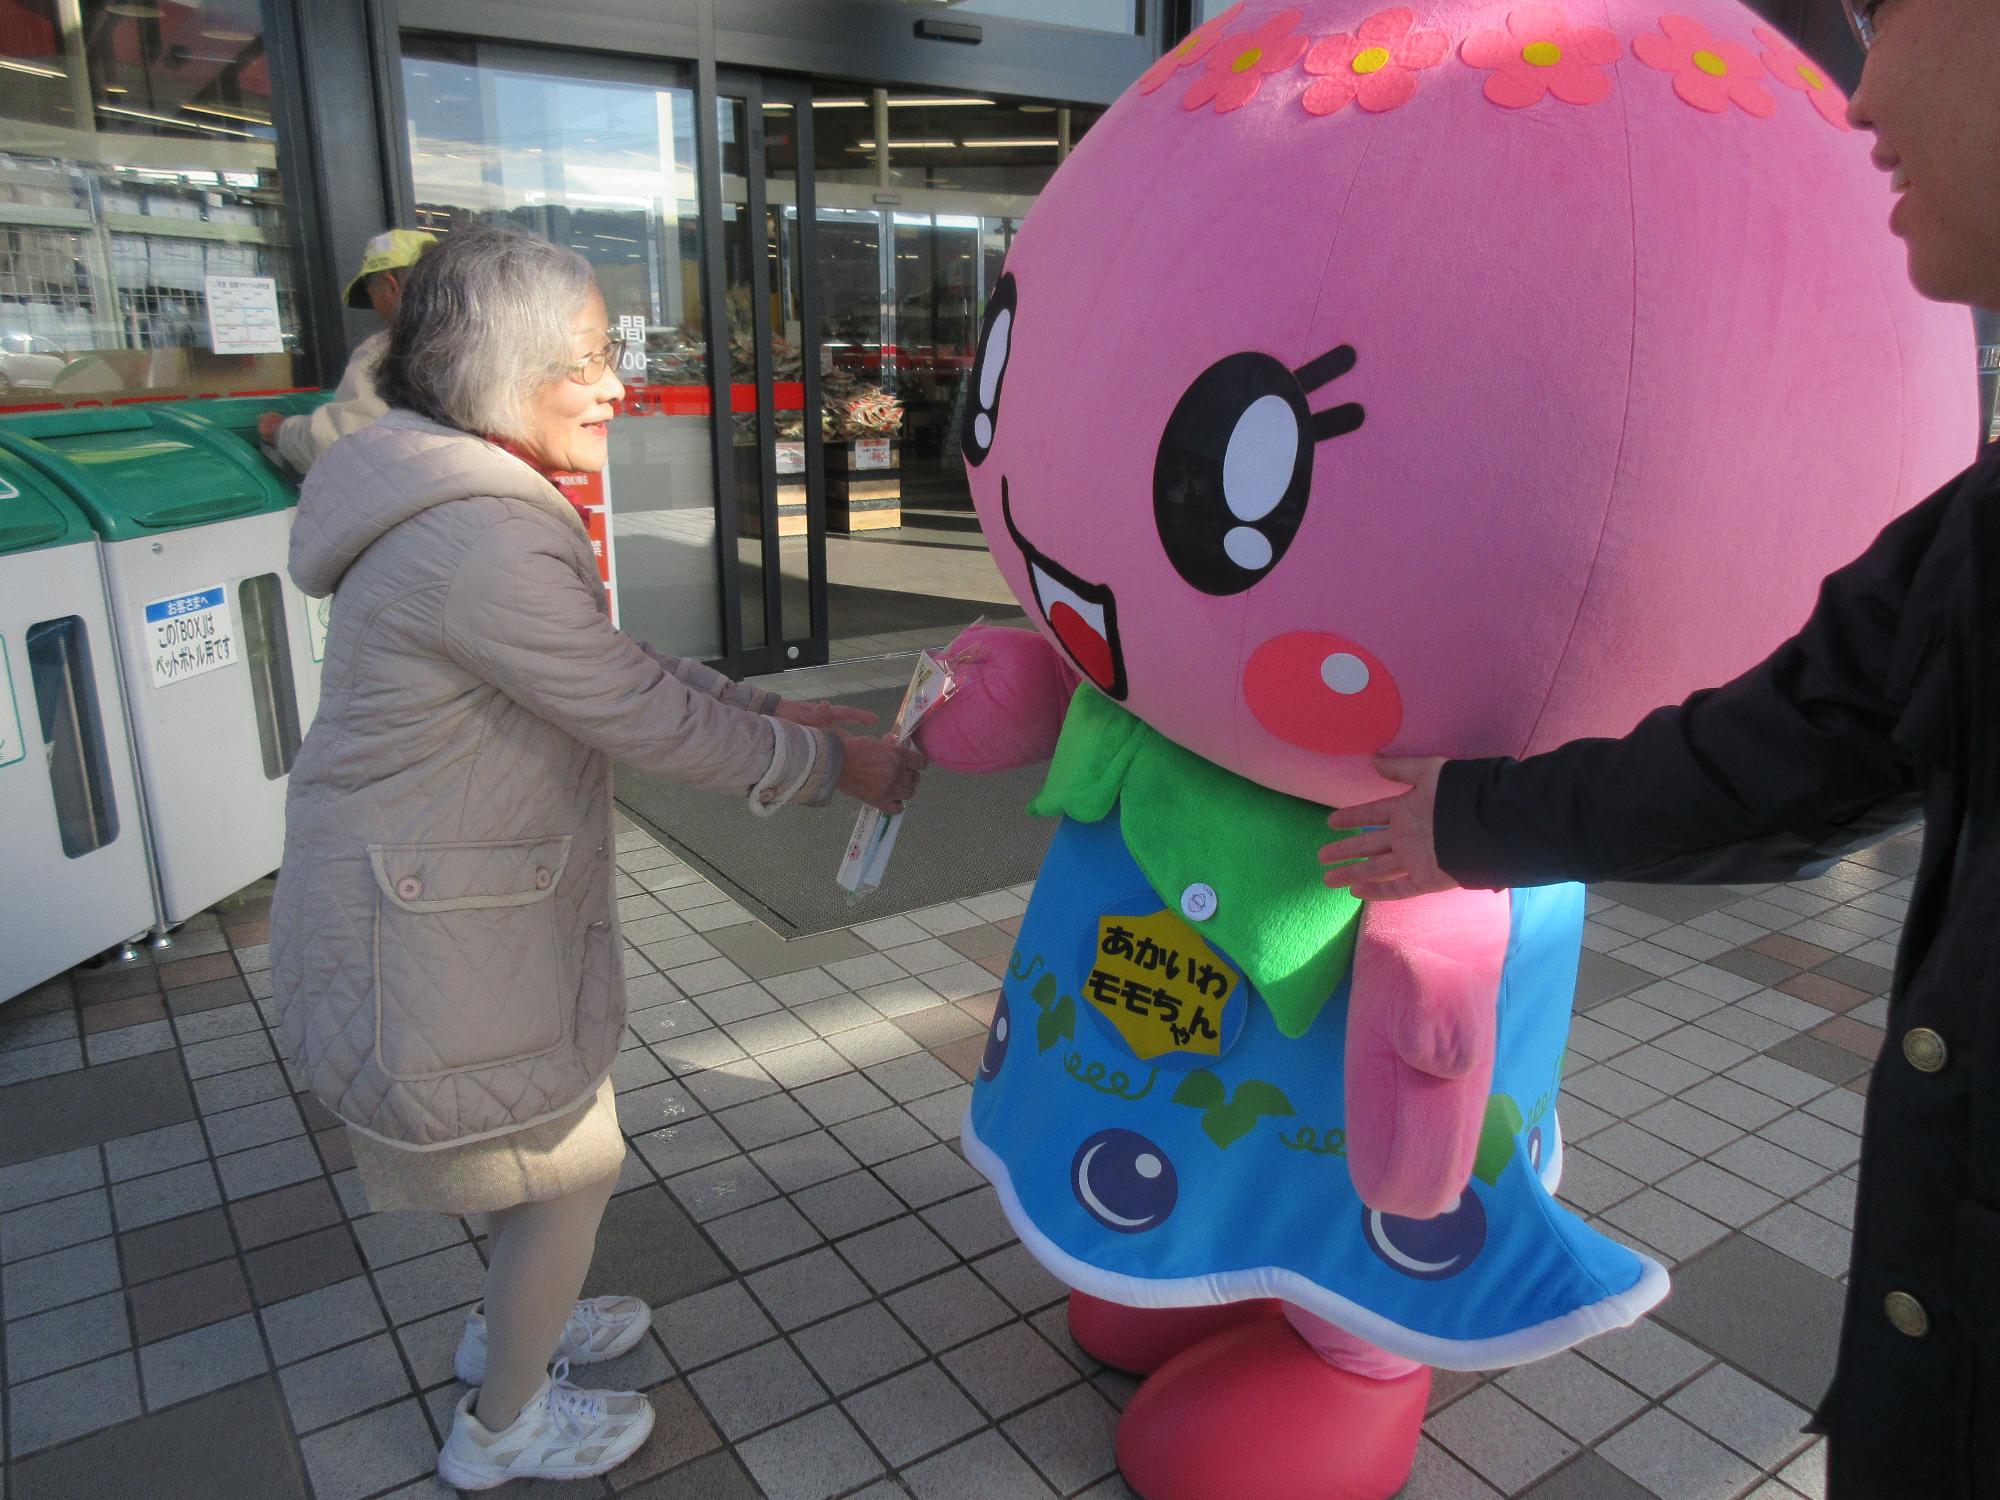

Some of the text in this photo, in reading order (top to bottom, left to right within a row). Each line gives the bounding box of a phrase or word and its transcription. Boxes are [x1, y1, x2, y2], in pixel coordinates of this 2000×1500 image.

[619, 315, 646, 343] 間
[1101, 926, 1228, 1000] あかいわ
[1088, 969, 1218, 1046] モモちゃん
